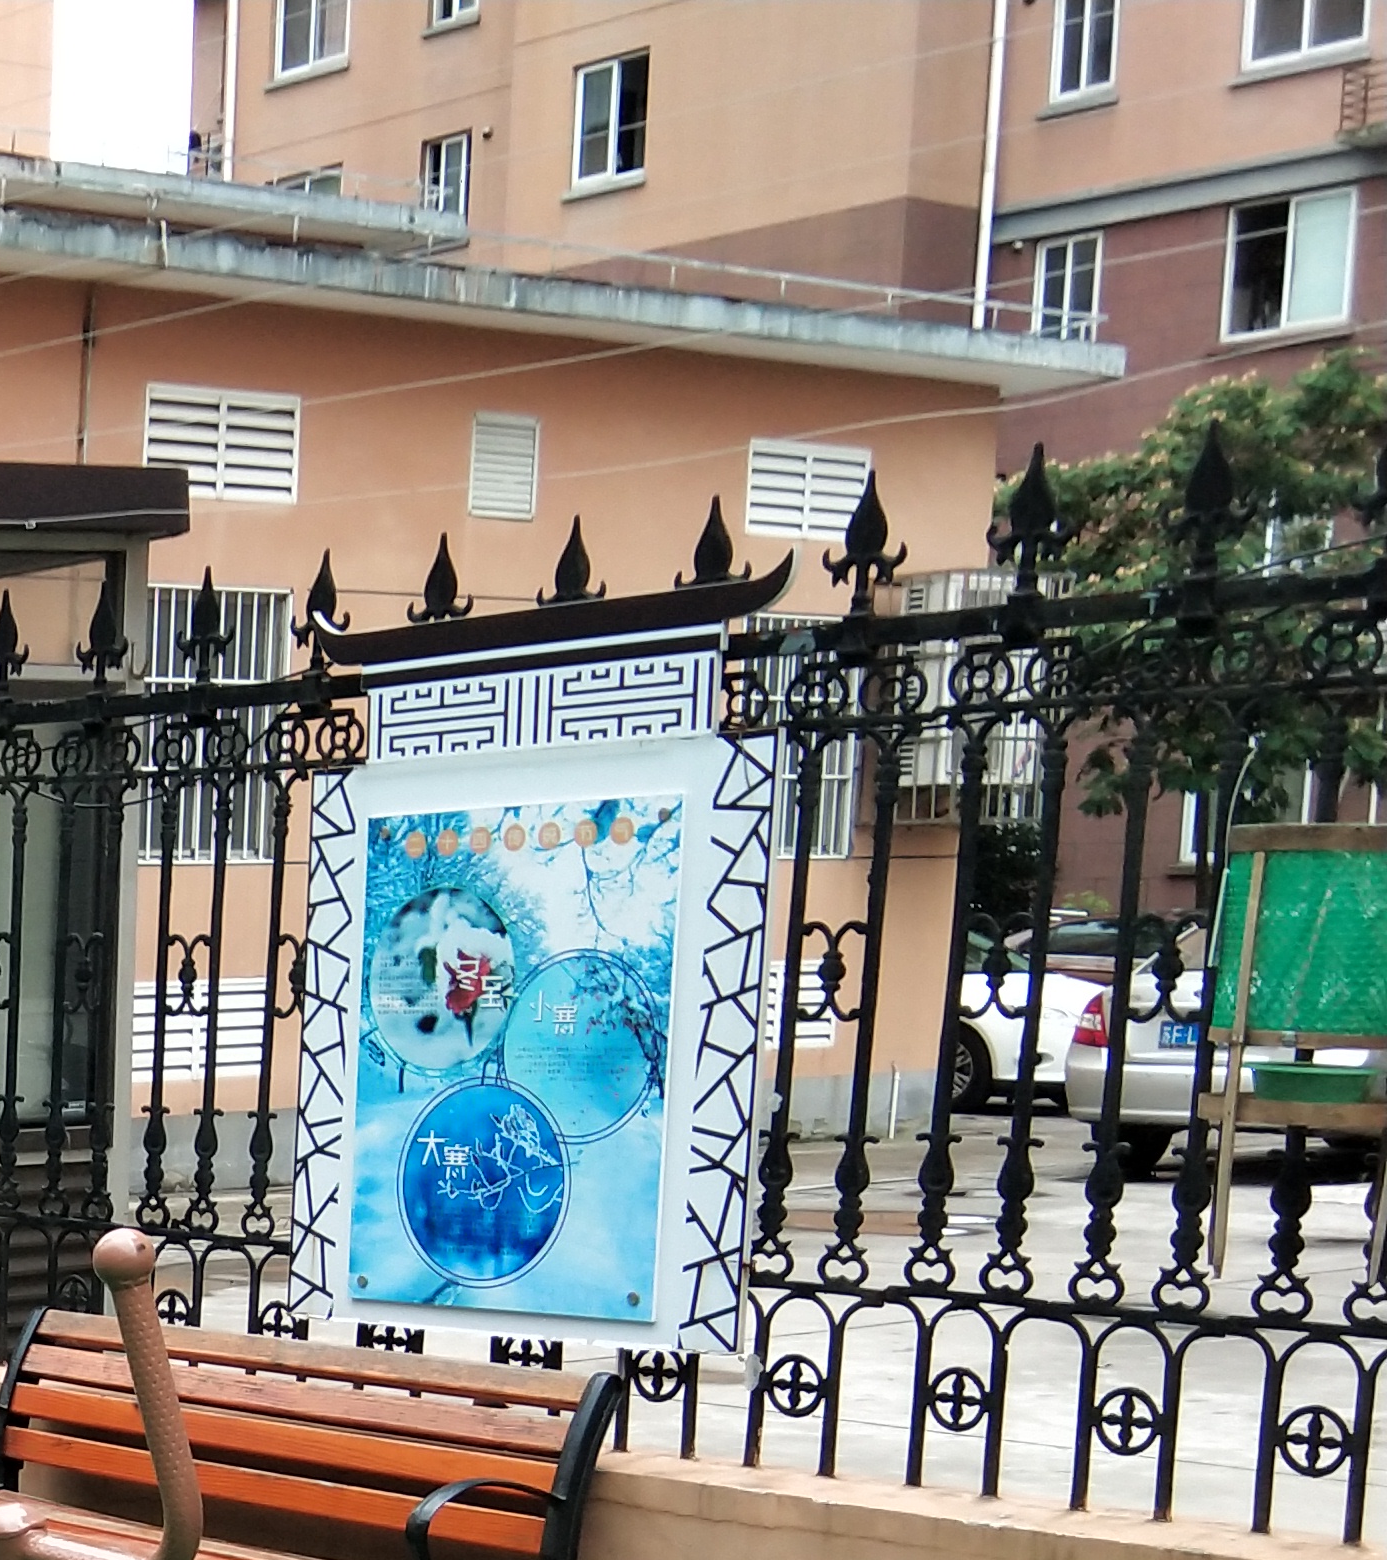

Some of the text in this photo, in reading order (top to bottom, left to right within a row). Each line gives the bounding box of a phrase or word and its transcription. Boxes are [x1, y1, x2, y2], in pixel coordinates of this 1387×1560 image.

[455, 959, 504, 1009] 冬至
[529, 989, 578, 1035] 小寒
[416, 1129, 471, 1180] 大寒
